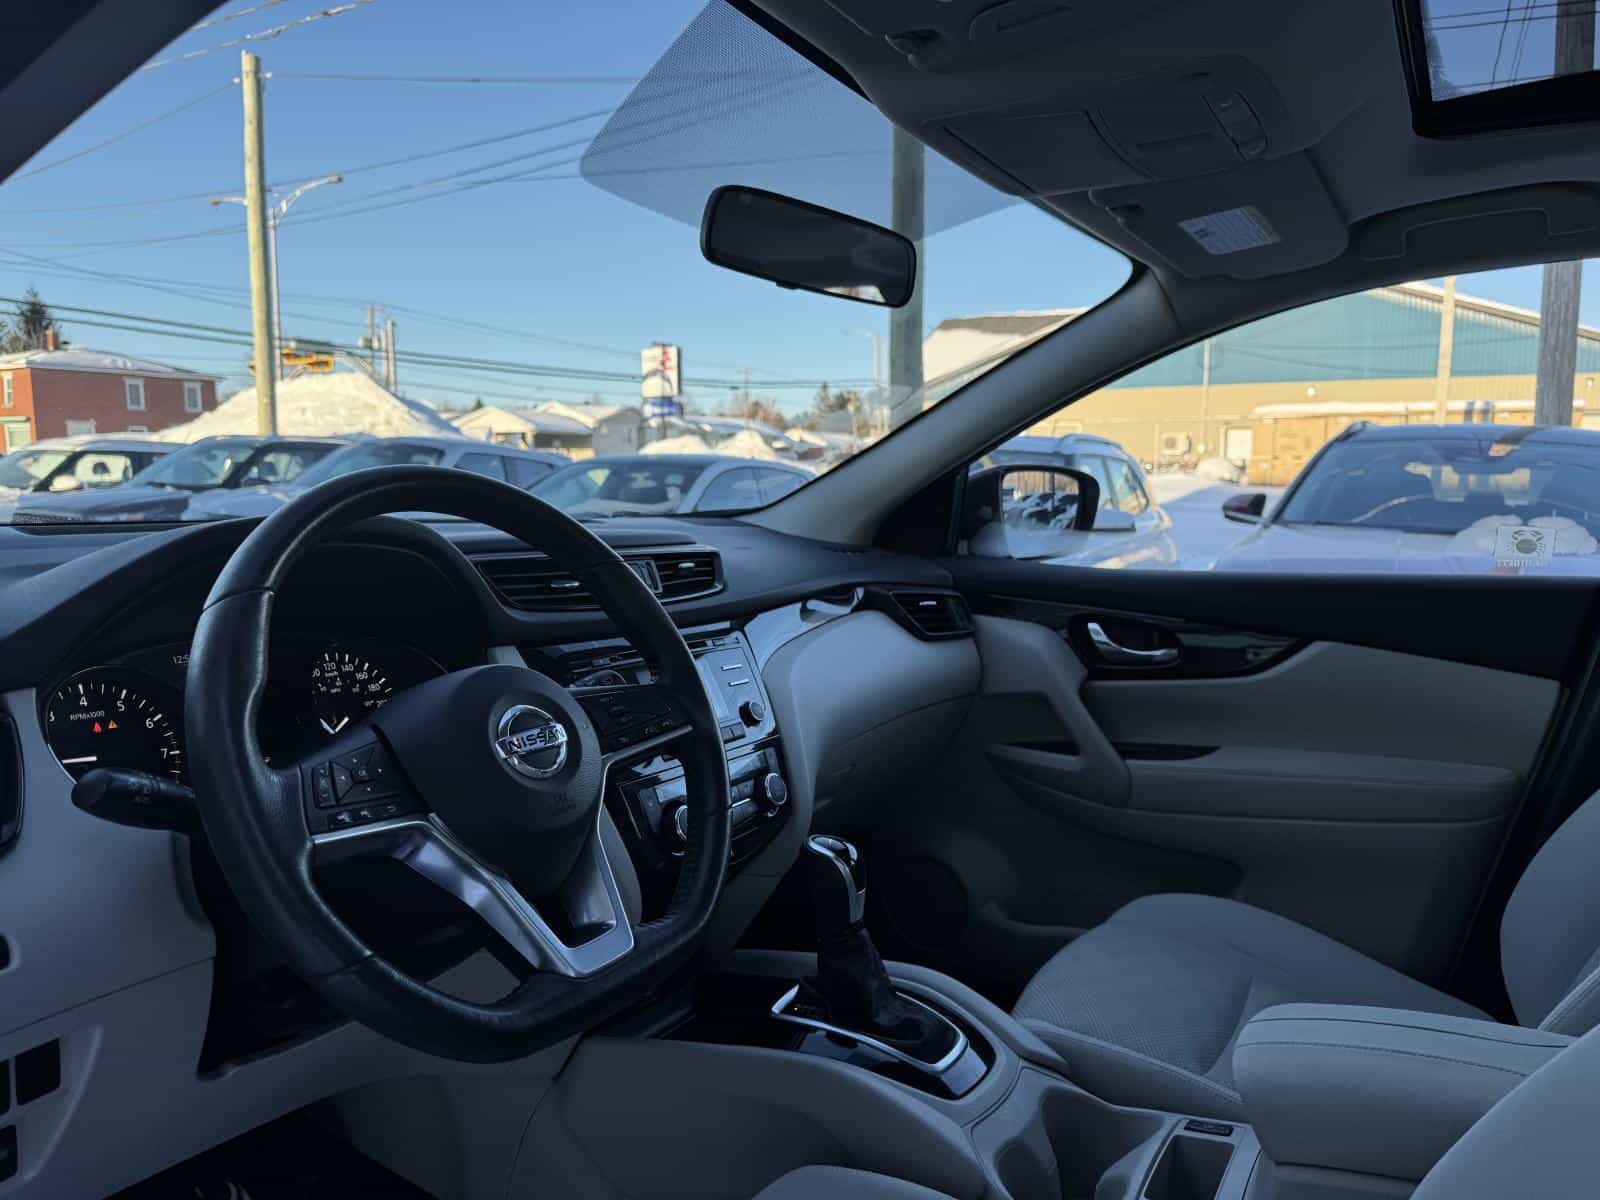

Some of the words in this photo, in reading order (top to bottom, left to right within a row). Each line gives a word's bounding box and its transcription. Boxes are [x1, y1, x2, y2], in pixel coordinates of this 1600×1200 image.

[323, 662, 336, 671] 120
[341, 663, 354, 672] 140
[355, 671, 368, 680] 160
[79, 696, 88, 707] 4
[116, 701, 126, 712] 5
[145, 718, 154, 729] 6
[507, 727, 566, 751] NISSAN
[160, 748, 168, 760] 7
